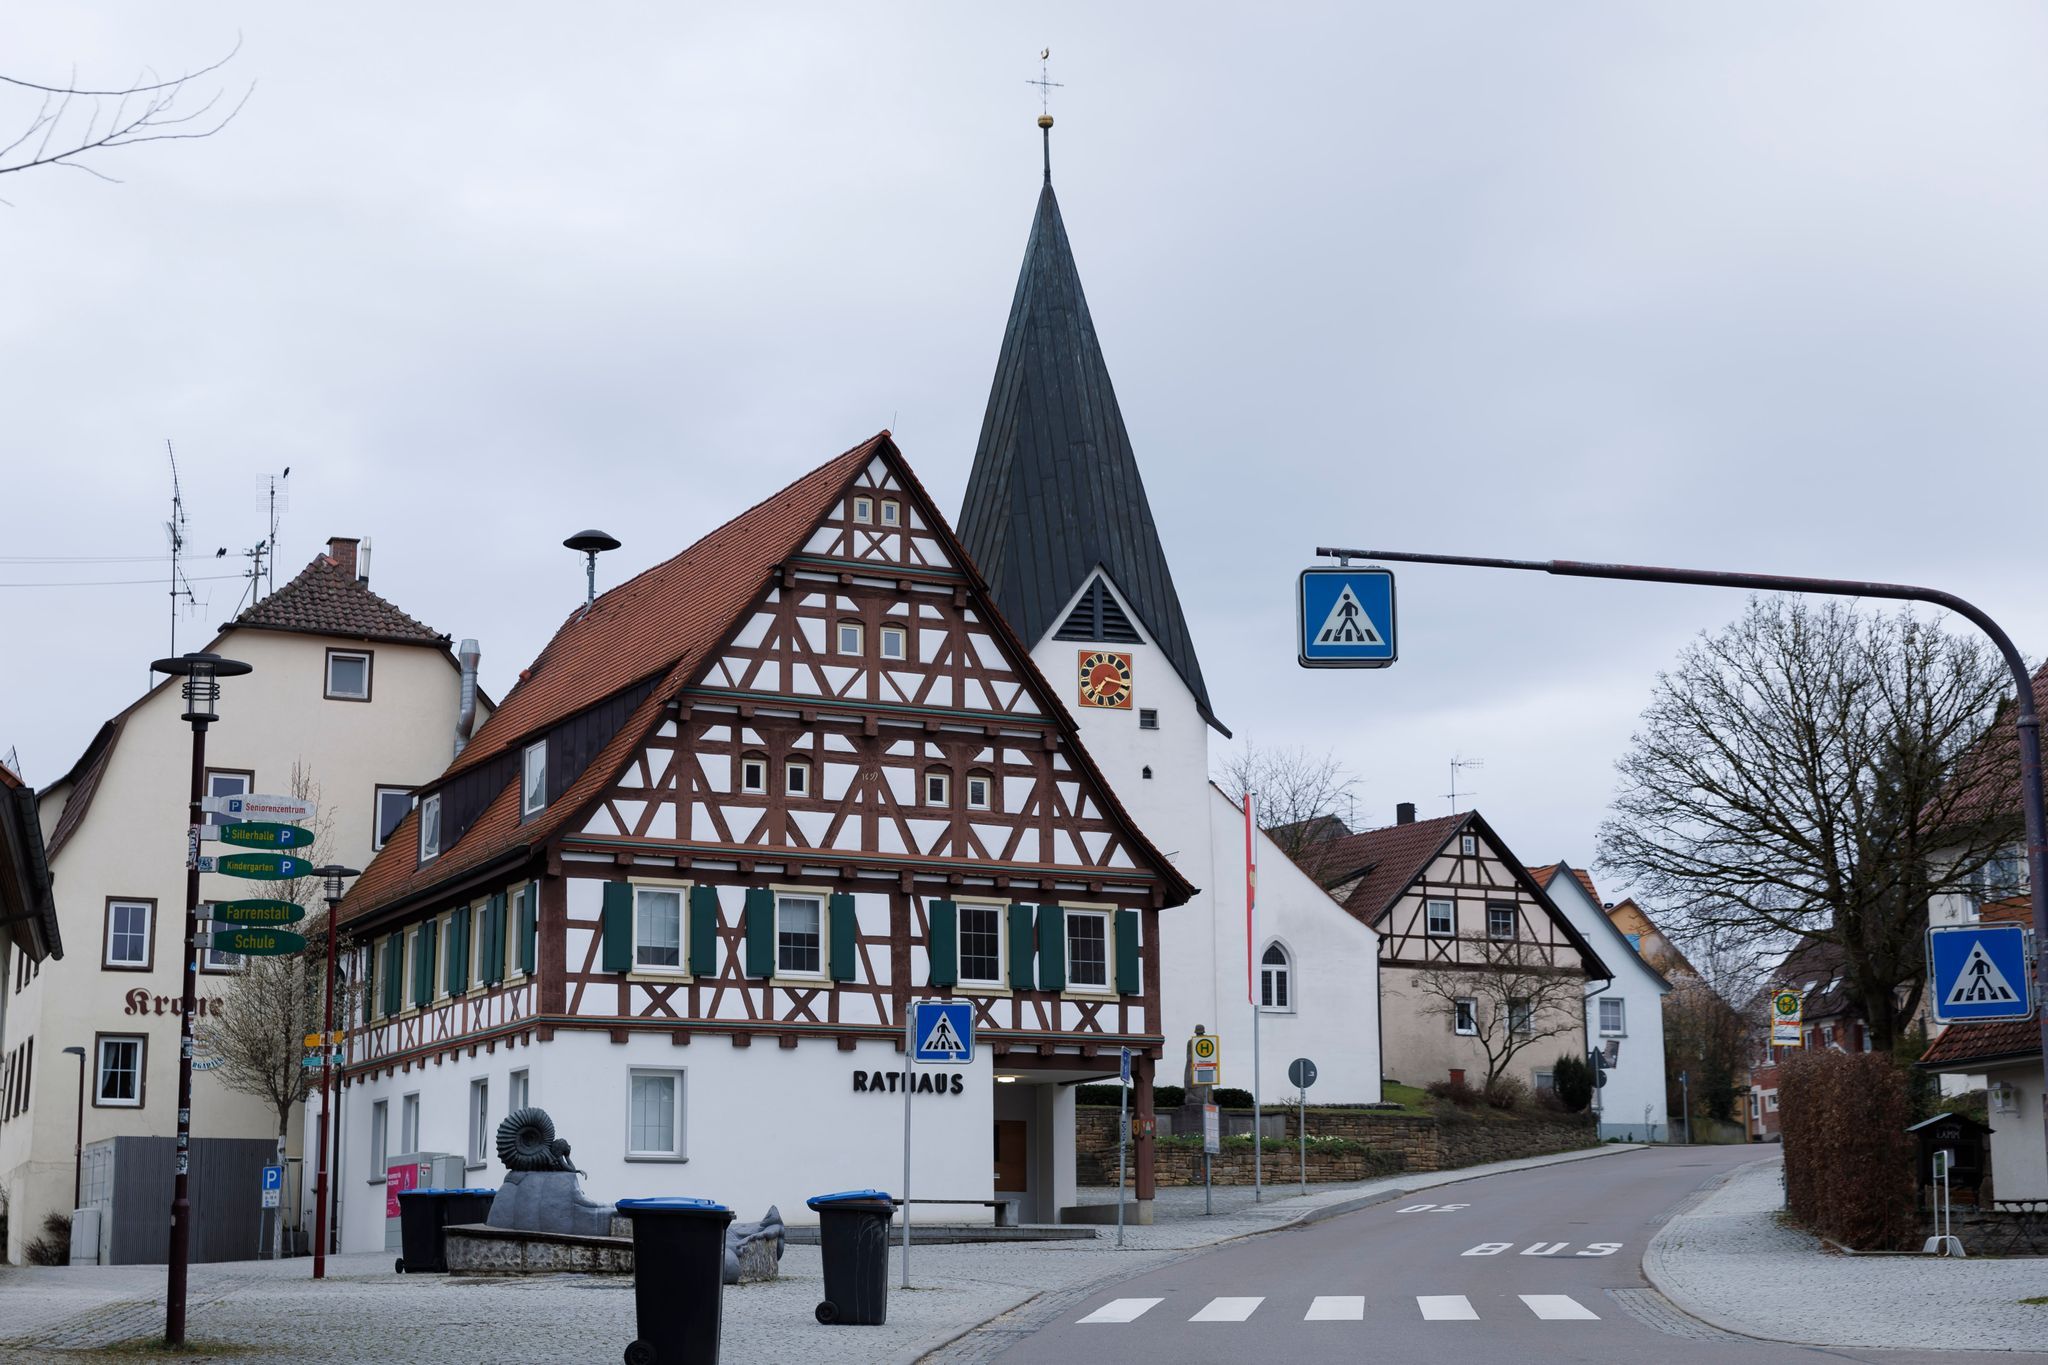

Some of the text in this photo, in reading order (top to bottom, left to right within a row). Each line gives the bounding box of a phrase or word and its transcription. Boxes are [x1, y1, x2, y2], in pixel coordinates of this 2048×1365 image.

[232, 802, 305, 814] P Seniorenzentrum
[231, 830, 290, 842] Sillerhalle P
[227, 861, 291, 872] Kindergarten P
[226, 905, 289, 920] Farrenstall
[235, 934, 275, 948] Schule
[124, 987, 224, 1017] Krone
[1200, 1043, 1209, 1053] H
[853, 1070, 964, 1094] RATHAUS
[266, 1170, 277, 1189] P
[1460, 1242, 1624, 1256] BUS
